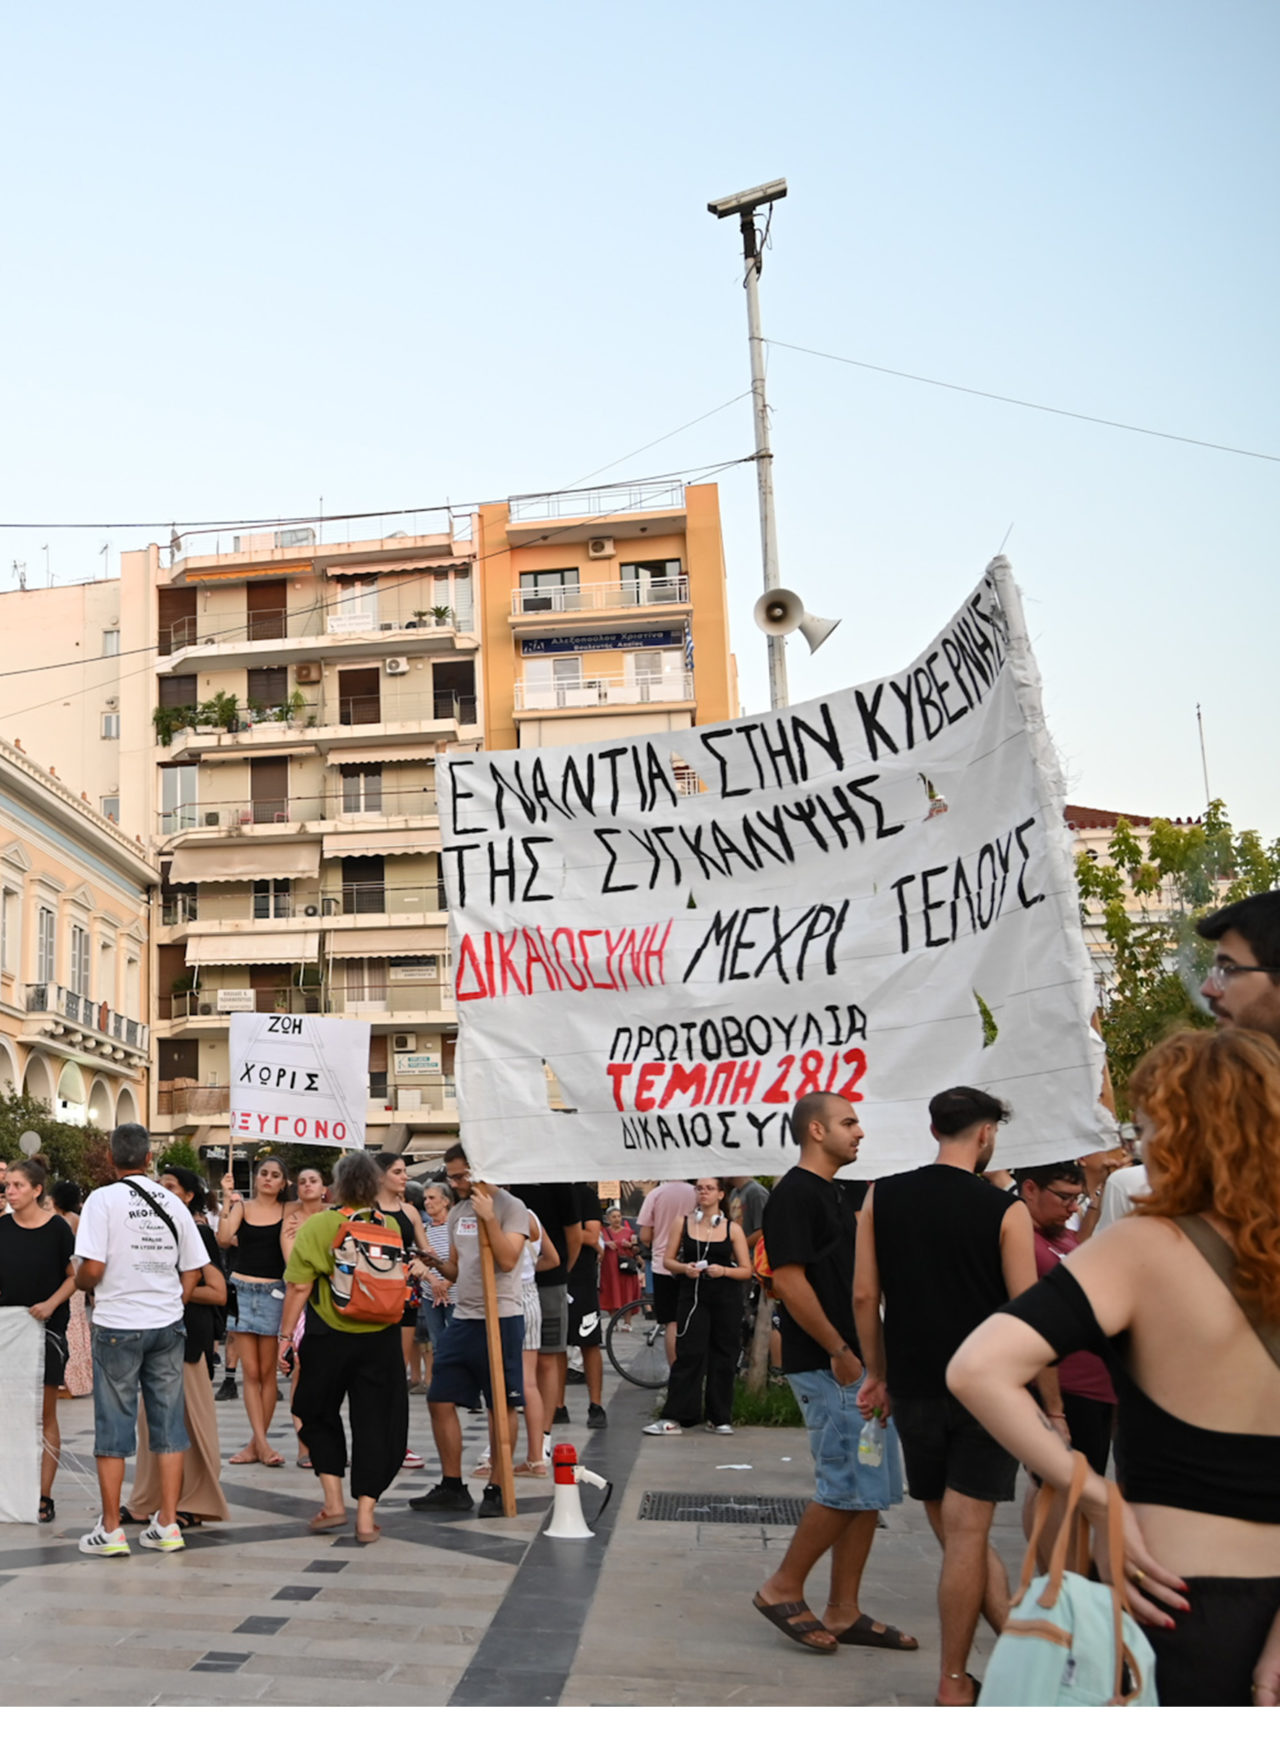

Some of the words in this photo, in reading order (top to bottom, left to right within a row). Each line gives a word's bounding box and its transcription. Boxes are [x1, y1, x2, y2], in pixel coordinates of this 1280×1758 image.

[451, 742, 679, 835] ΕΝΑΝΤΙΑ
[700, 702, 845, 799] ΣΤΗΝ
[854, 578, 1009, 762] ΚΥΒΕΡΝΗΣ
[444, 836, 554, 907] ΤΗΣ
[594, 774, 905, 894] ΣΥΓΚΑΛΥΨΗΣ
[456, 918, 673, 1001] ΔΙΚΑΙΟΣΥΝΗ
[682, 898, 850, 984] ΜΕΧΡΙ
[890, 817, 1046, 954] ΤΕΛΟΥΣ
[268, 1015, 303, 1035] ΖΩΗ
[609, 1004, 867, 1062] ΠΡΩΤΟΒΟΥΛΙΑ
[240, 1062, 319, 1092] ΧΩΡΙΣ
[606, 1060, 762, 1112] ΤΕΜΠΗ
[231, 1111, 346, 1141] ΟΞΥΓΟΝΟ
[621, 1110, 801, 1150] ΔΙΚΑΙΟΣΥΝ
